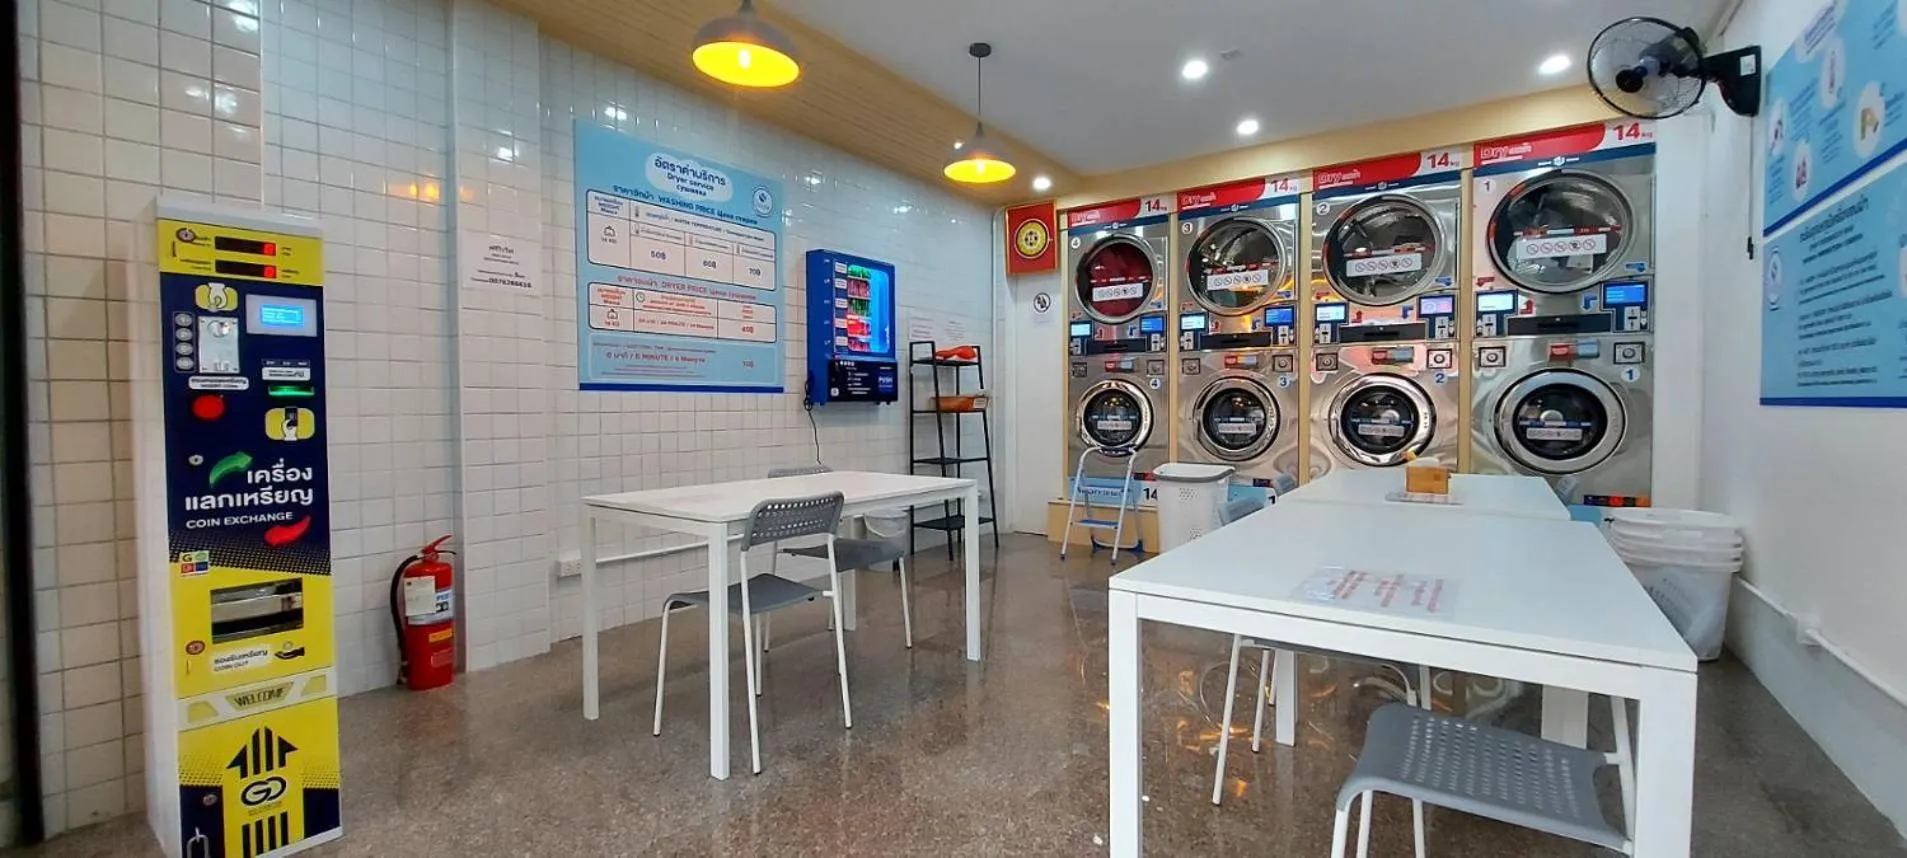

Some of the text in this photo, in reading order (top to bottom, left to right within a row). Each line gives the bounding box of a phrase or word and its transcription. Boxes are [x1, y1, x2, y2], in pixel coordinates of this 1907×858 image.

[1614, 122, 1641, 141] 14
[1427, 152, 1449, 169] 14
[654, 155, 726, 187] อัตราค่าบริการ
[667, 172, 714, 191] Dryer service
[1271, 178, 1289, 192] 14
[1484, 180, 1491, 191] 1
[658, 194, 716, 215] WASHING PRICE
[1144, 199, 1160, 212] 14
[1319, 204, 1327, 214] 2
[1073, 238, 1079, 247] 4
[1435, 373, 1445, 383] 2
[1625, 369, 1634, 380] 1
[1151, 379, 1158, 388] 4
[1279, 378, 1287, 387] 3
[247, 457, 313, 484] เครื่อง
[185, 485, 313, 511] แลกเหรียญ
[185, 511, 294, 530] COIN EXCHANGE
[234, 687, 284, 707] WELCOME
